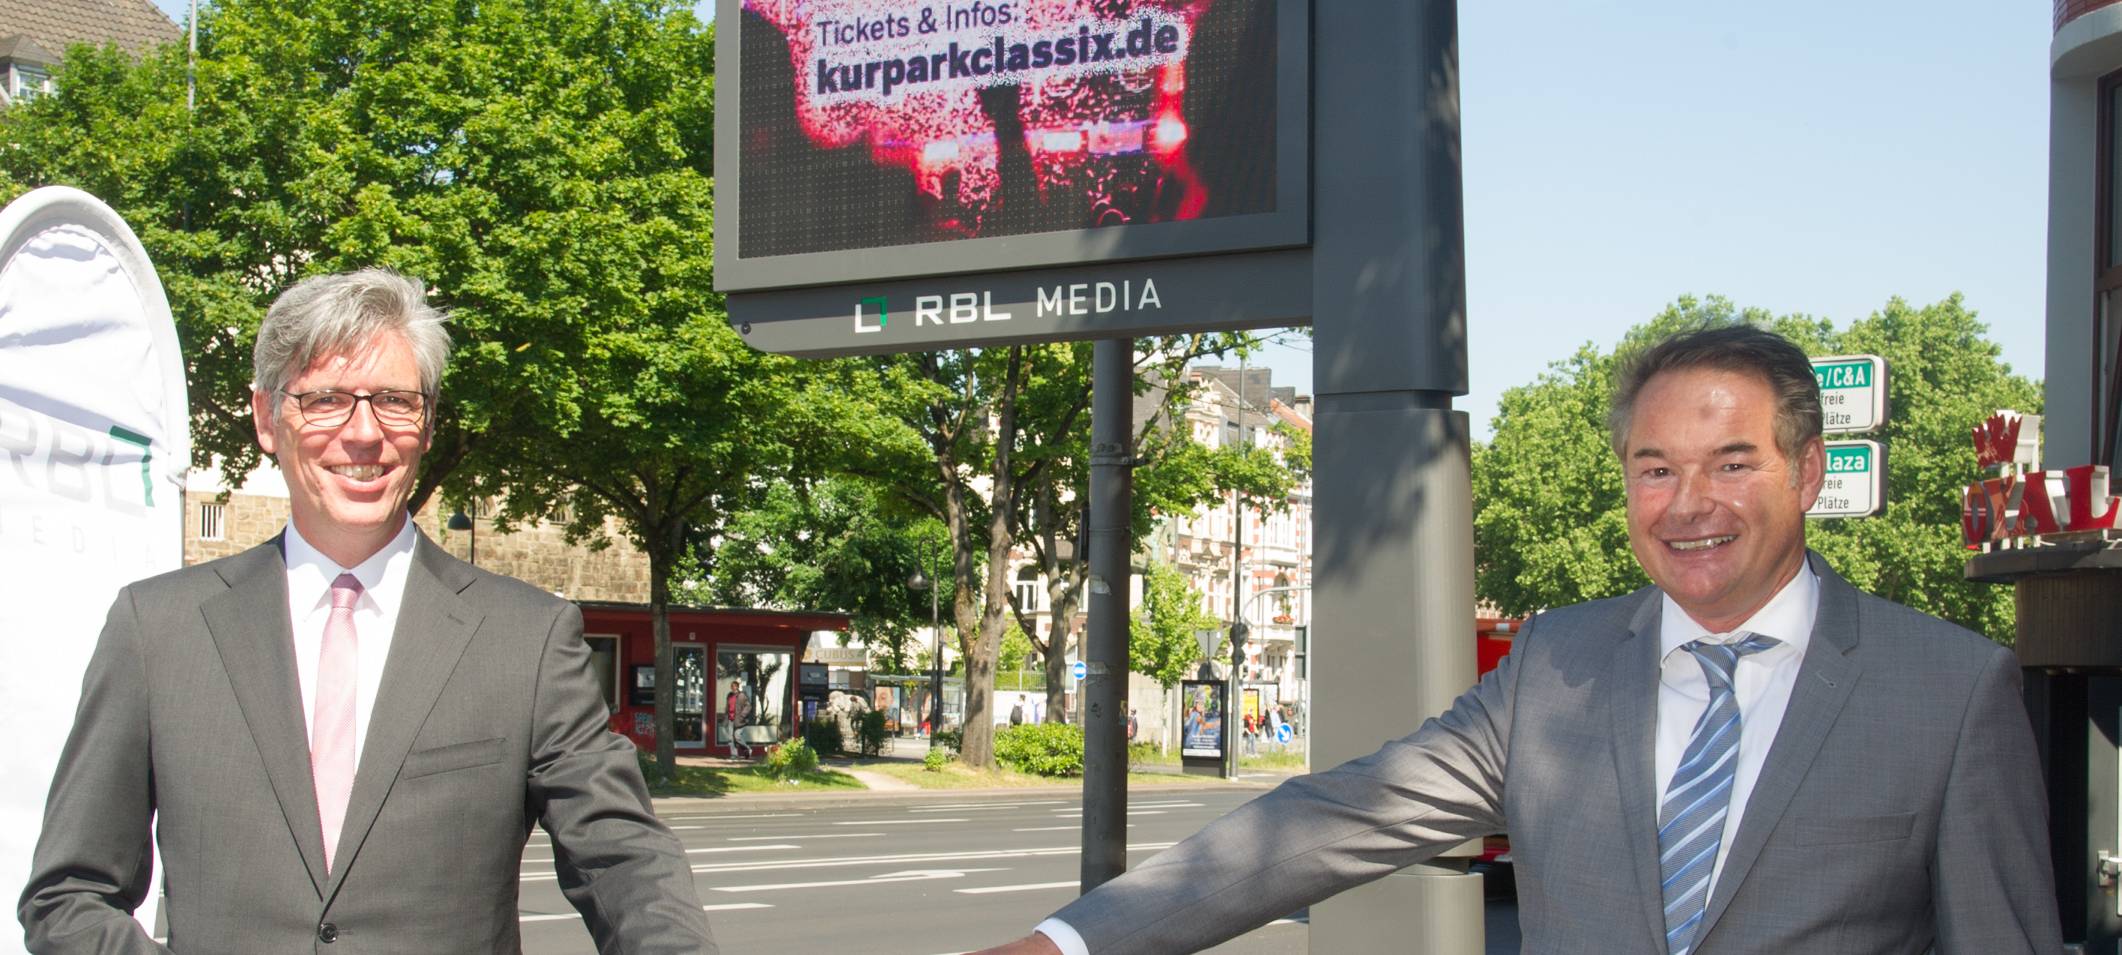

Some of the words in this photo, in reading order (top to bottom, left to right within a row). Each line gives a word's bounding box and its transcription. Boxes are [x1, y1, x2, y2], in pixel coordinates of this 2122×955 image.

[817, 13, 909, 46] Tickets
[917, 7, 938, 33] &
[946, 0, 1018, 31] Infos:
[817, 18, 1180, 96] kurparkclassix.de
[915, 290, 1012, 326] RBL
[1036, 278, 1162, 318] MEDIA
[1816, 366, 1866, 387] e/C&A
[1824, 410, 1851, 425] lätze
[1826, 451, 1866, 471] laza
[1823, 476, 1843, 490] reie
[1817, 495, 1849, 510] Plätze
